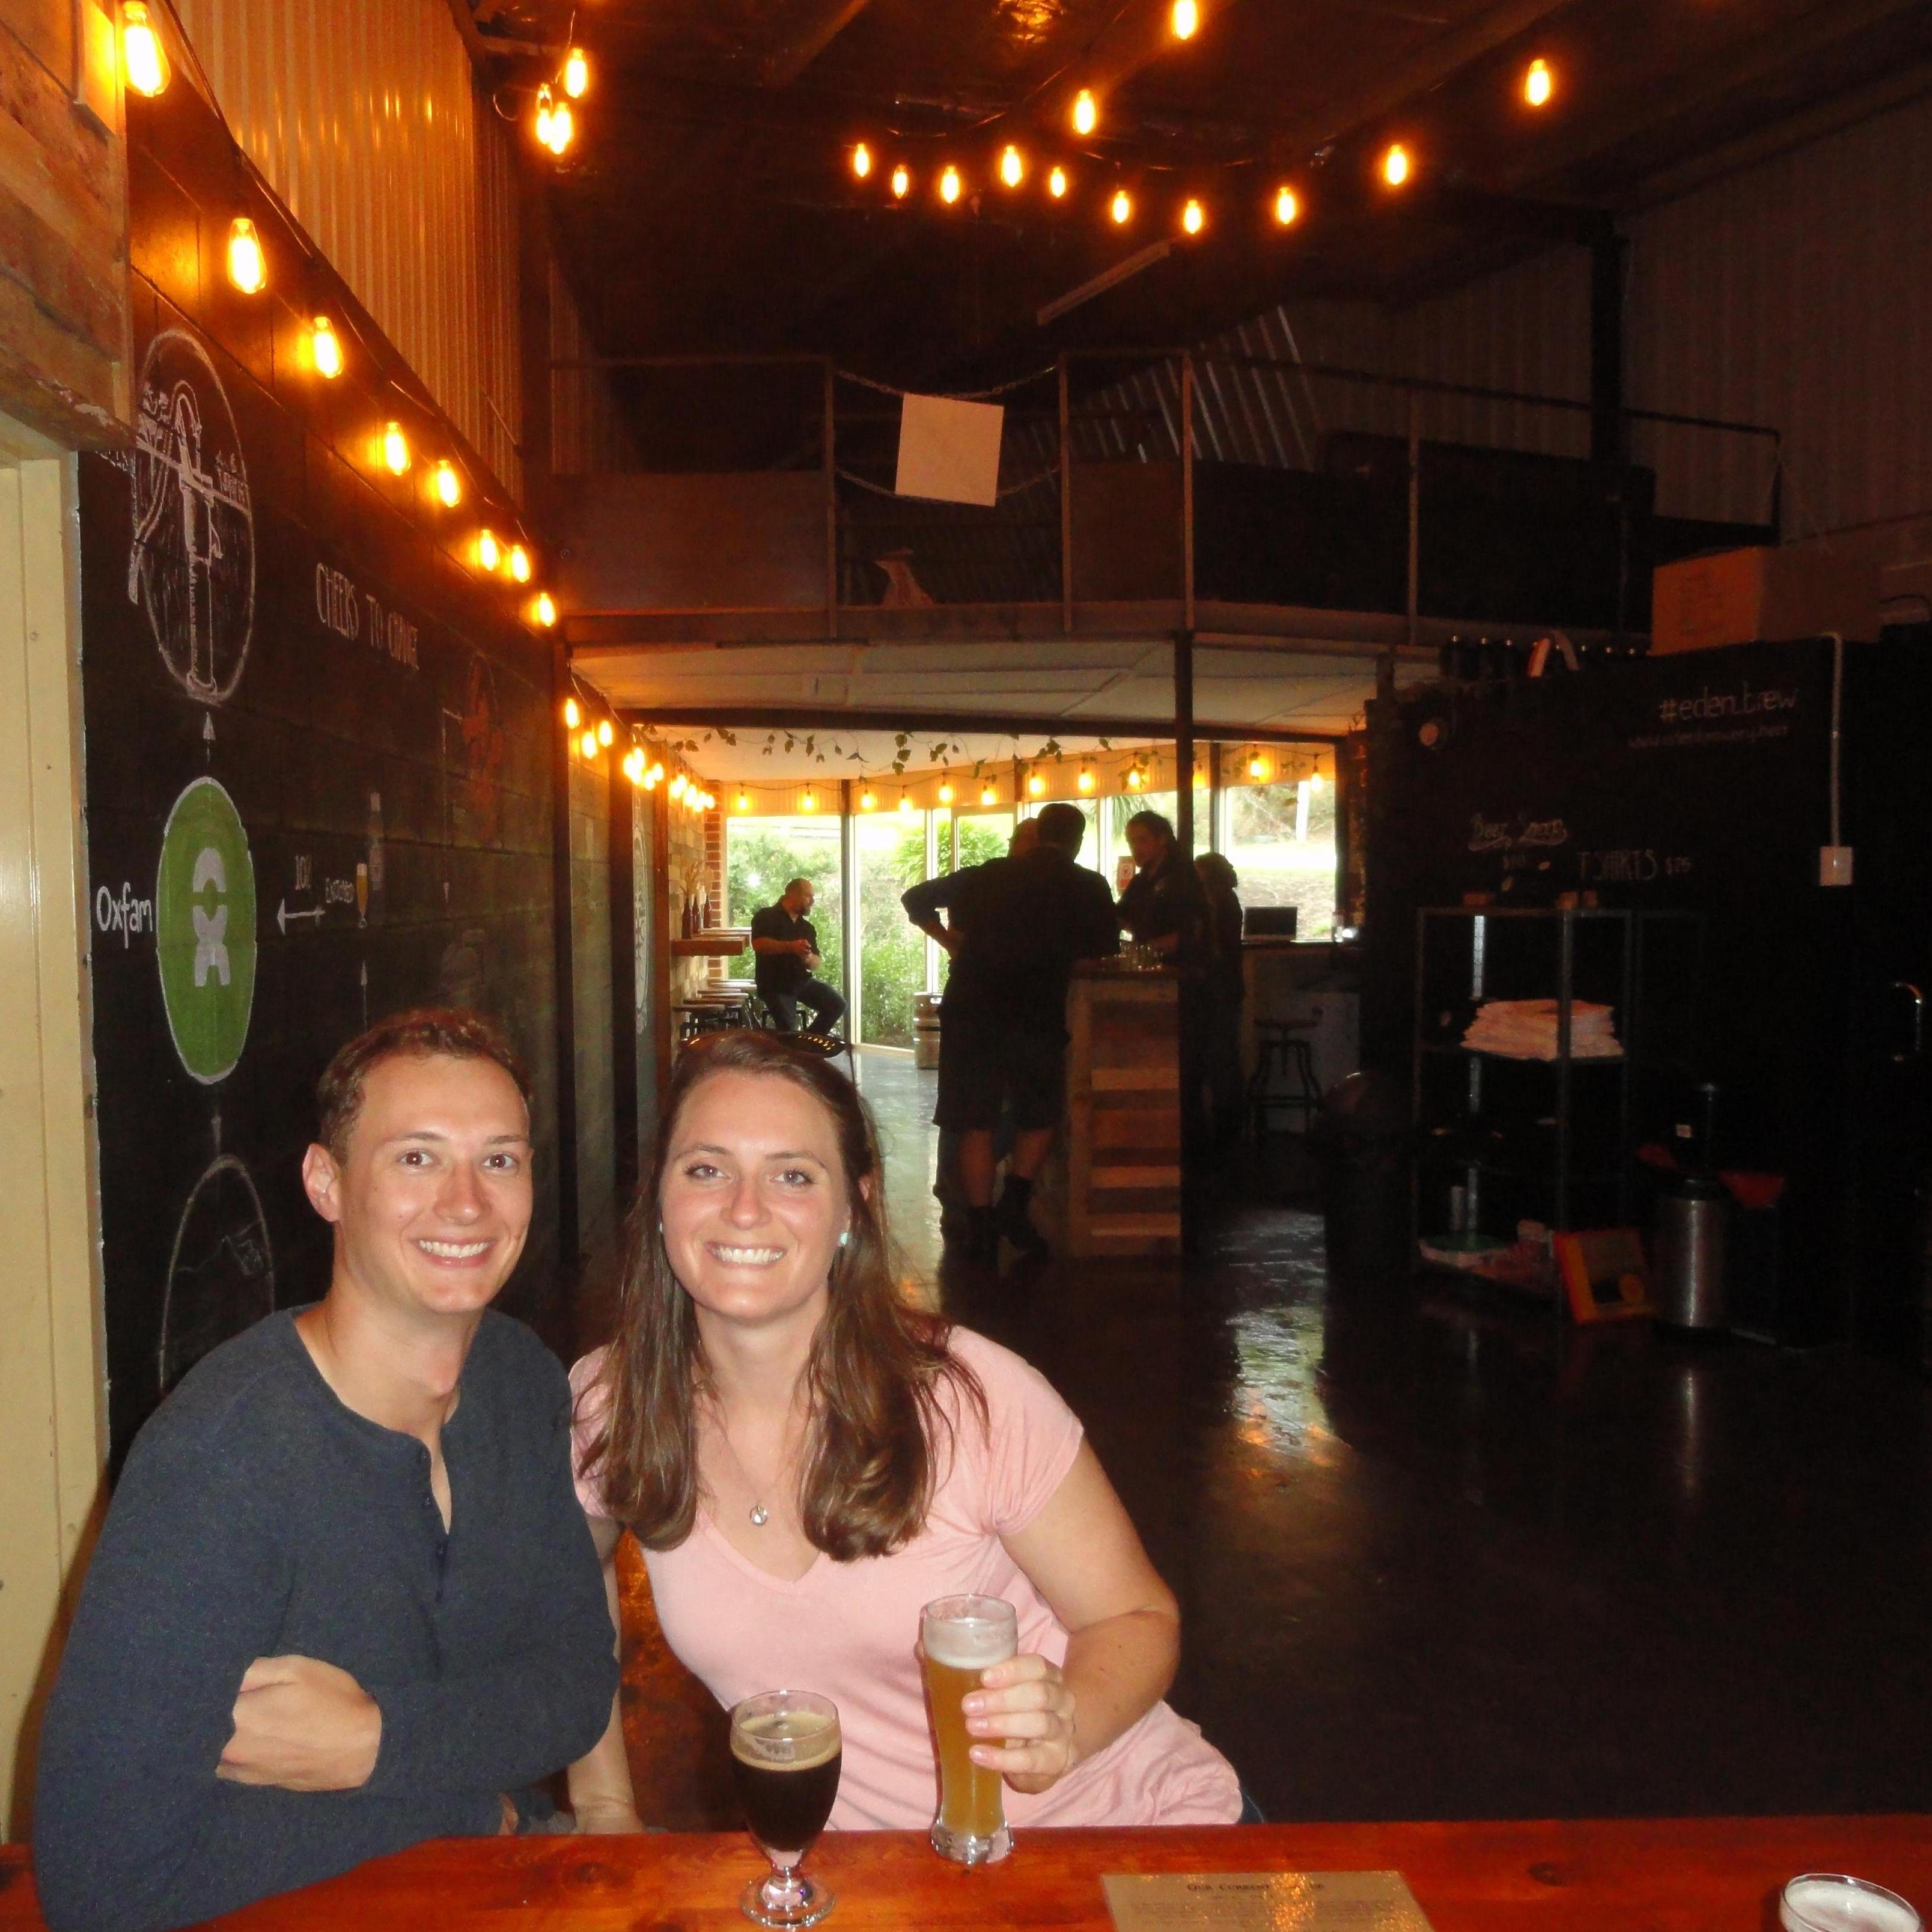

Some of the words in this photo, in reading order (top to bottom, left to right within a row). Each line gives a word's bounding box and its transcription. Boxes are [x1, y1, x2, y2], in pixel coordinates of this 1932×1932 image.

[316, 562, 359, 641] CHEERS
[366, 593, 385, 650] TO
[96, 882, 153, 949] Oxfam
